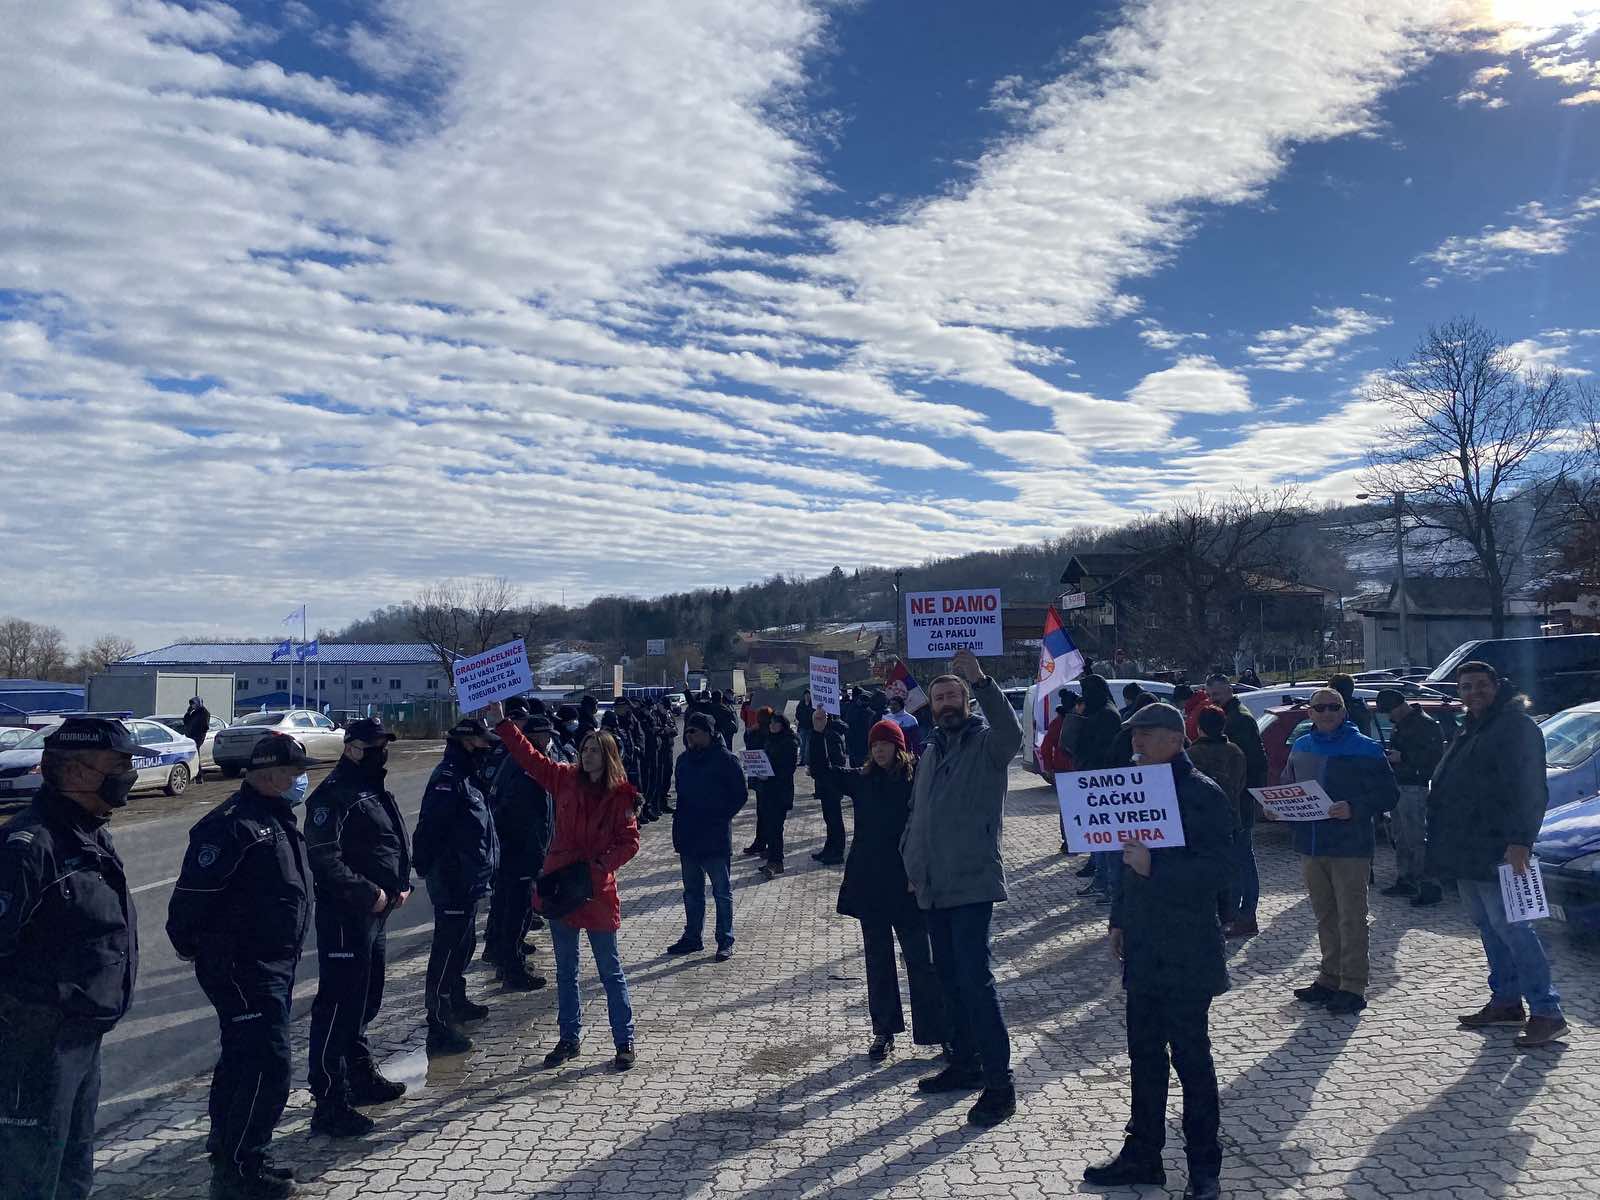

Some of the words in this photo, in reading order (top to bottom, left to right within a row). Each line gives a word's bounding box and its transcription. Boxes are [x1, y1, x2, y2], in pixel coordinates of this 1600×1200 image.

[911, 598, 935, 615] NE
[943, 595, 998, 613] DAMO
[913, 617, 945, 627] METAR
[948, 615, 996, 626] DEDOVINE
[930, 630, 943, 639] ZA
[946, 629, 977, 639] PAKLU
[927, 641, 984, 652] CIGARETA!!!
[460, 676, 469, 684] DA
[470, 672, 477, 681] LI
[478, 666, 495, 679] VAŠU
[495, 656, 522, 671] ZEMLJU
[468, 673, 506, 691] PRODAJETE
[506, 670, 516, 678] ZA
[498, 682, 507, 691] PO
[508, 677, 522, 687] ARU
[132, 756, 163, 770] ЛИЦИЈА
[1077, 774, 1126, 789] SAMO
[1131, 772, 1143, 785] U
[1086, 790, 1145, 807] ČAČKU
[1263, 787, 1304, 800] STOP
[1306, 795, 1320, 803] NA
[1073, 814, 1082, 826] 1
[1088, 813, 1112, 826] AR
[1114, 808, 1168, 824] VREDI
[1083, 831, 1113, 844] 100
[1117, 828, 1165, 843] EURA
[1521, 872, 1532, 896] ДАМО
[1526, 898, 1534, 909] НЕ
